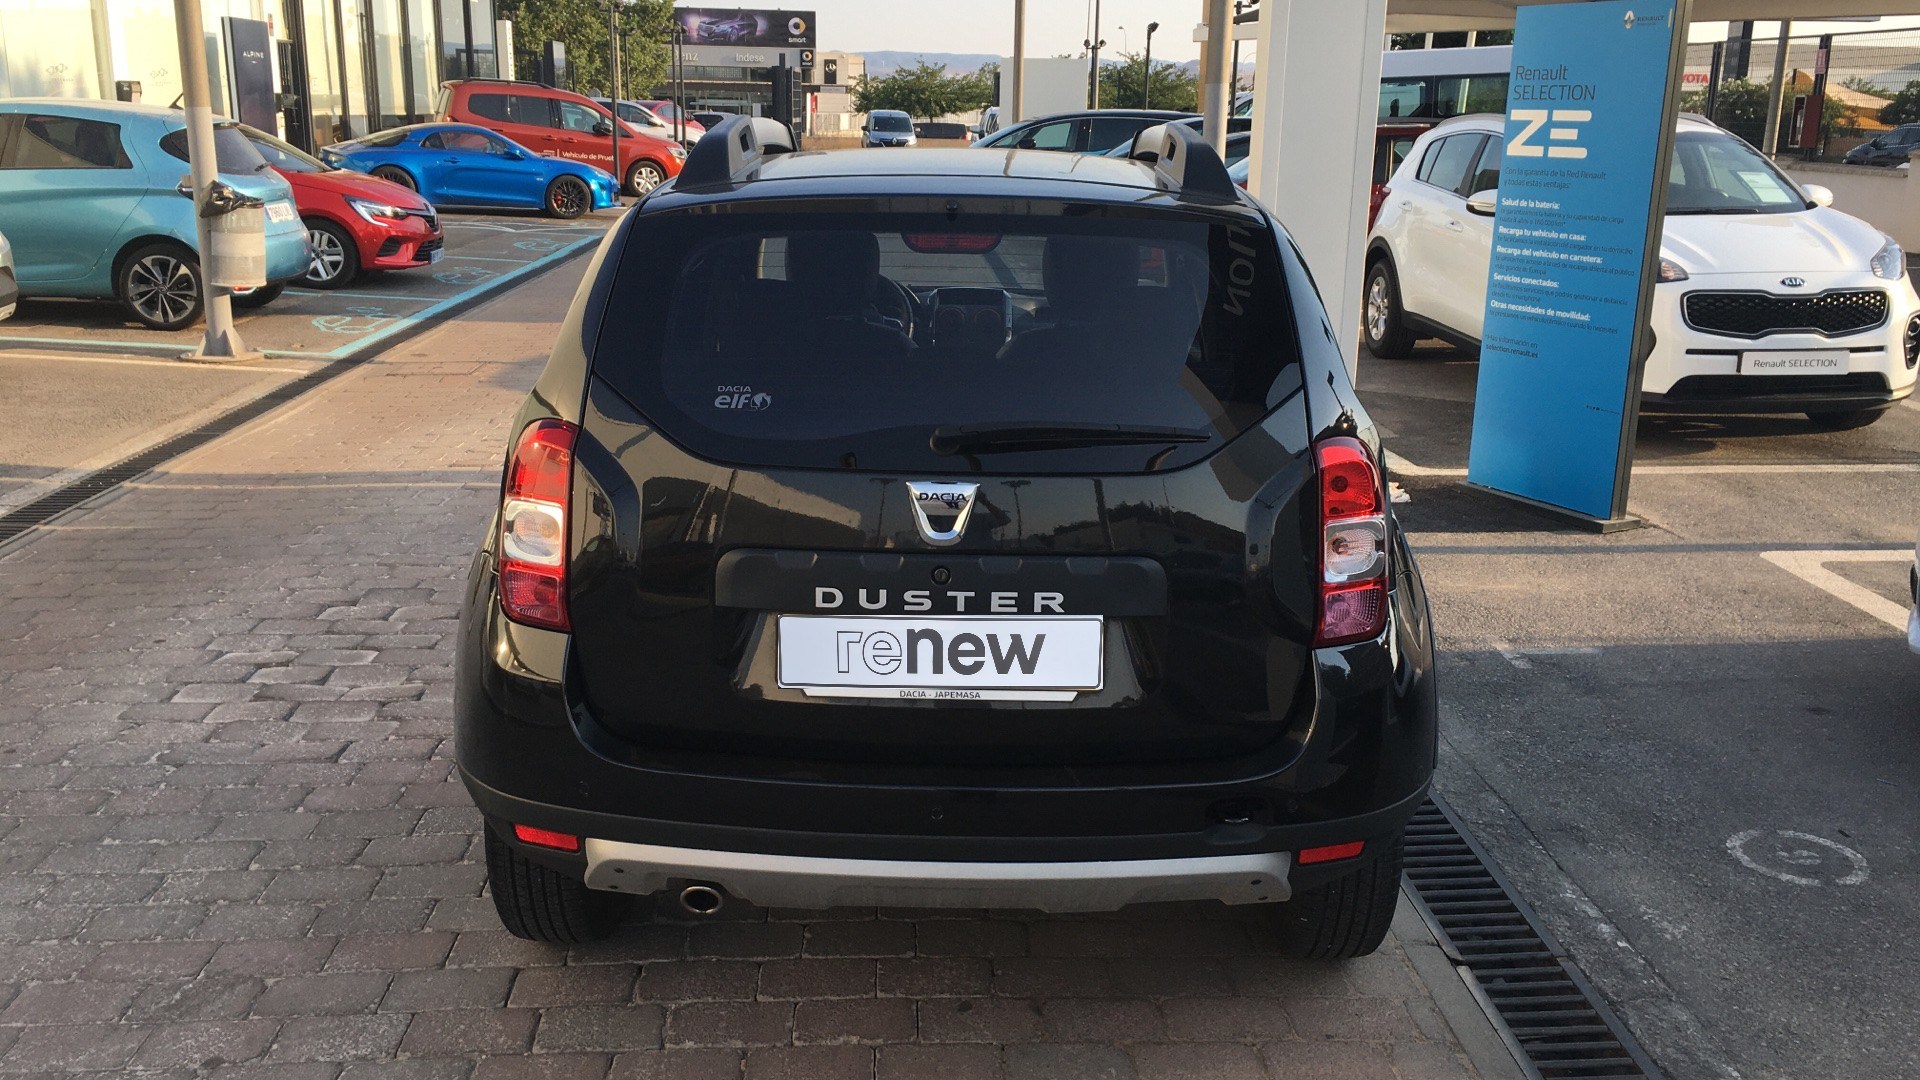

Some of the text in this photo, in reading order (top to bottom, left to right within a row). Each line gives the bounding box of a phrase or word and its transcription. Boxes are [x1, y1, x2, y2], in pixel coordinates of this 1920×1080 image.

[243, 50, 265, 59] ALPINE
[736, 52, 765, 62] Indese
[1515, 64, 1569, 81] Renault
[1682, 73, 1709, 85] YOTA
[1513, 84, 1596, 101] SELECTION
[1506, 109, 1592, 159] ZE
[589, 152, 598, 160] de
[1550, 169, 1559, 177] de
[1560, 170, 1565, 178] la
[1566, 171, 1580, 179] Red
[1580, 171, 1606, 180] Renault
[1501, 197, 1561, 210] Salud de la batería:
[1498, 225, 1524, 237] Recarga
[1524, 228, 1531, 236] tu
[1569, 232, 1587, 242] casa:
[1496, 245, 1521, 257] Recarga
[1522, 247, 1531, 256] del
[1569, 253, 1603, 264] carretera:
[1493, 272, 1560, 288] Servicios conectados:
[1490, 299, 1591, 322] Otras necesidades de movilidad:
[1753, 358, 1838, 368] Renault SELECTION
[717, 385, 752, 393] DACIA
[714, 393, 752, 409] elf
[919, 493, 967, 501] DACIA
[814, 586, 1066, 613] DUSTER
[836, 628, 1047, 675] renew
[899, 690, 927, 698] DACIA
[934, 690, 982, 699] JAPEMASA
